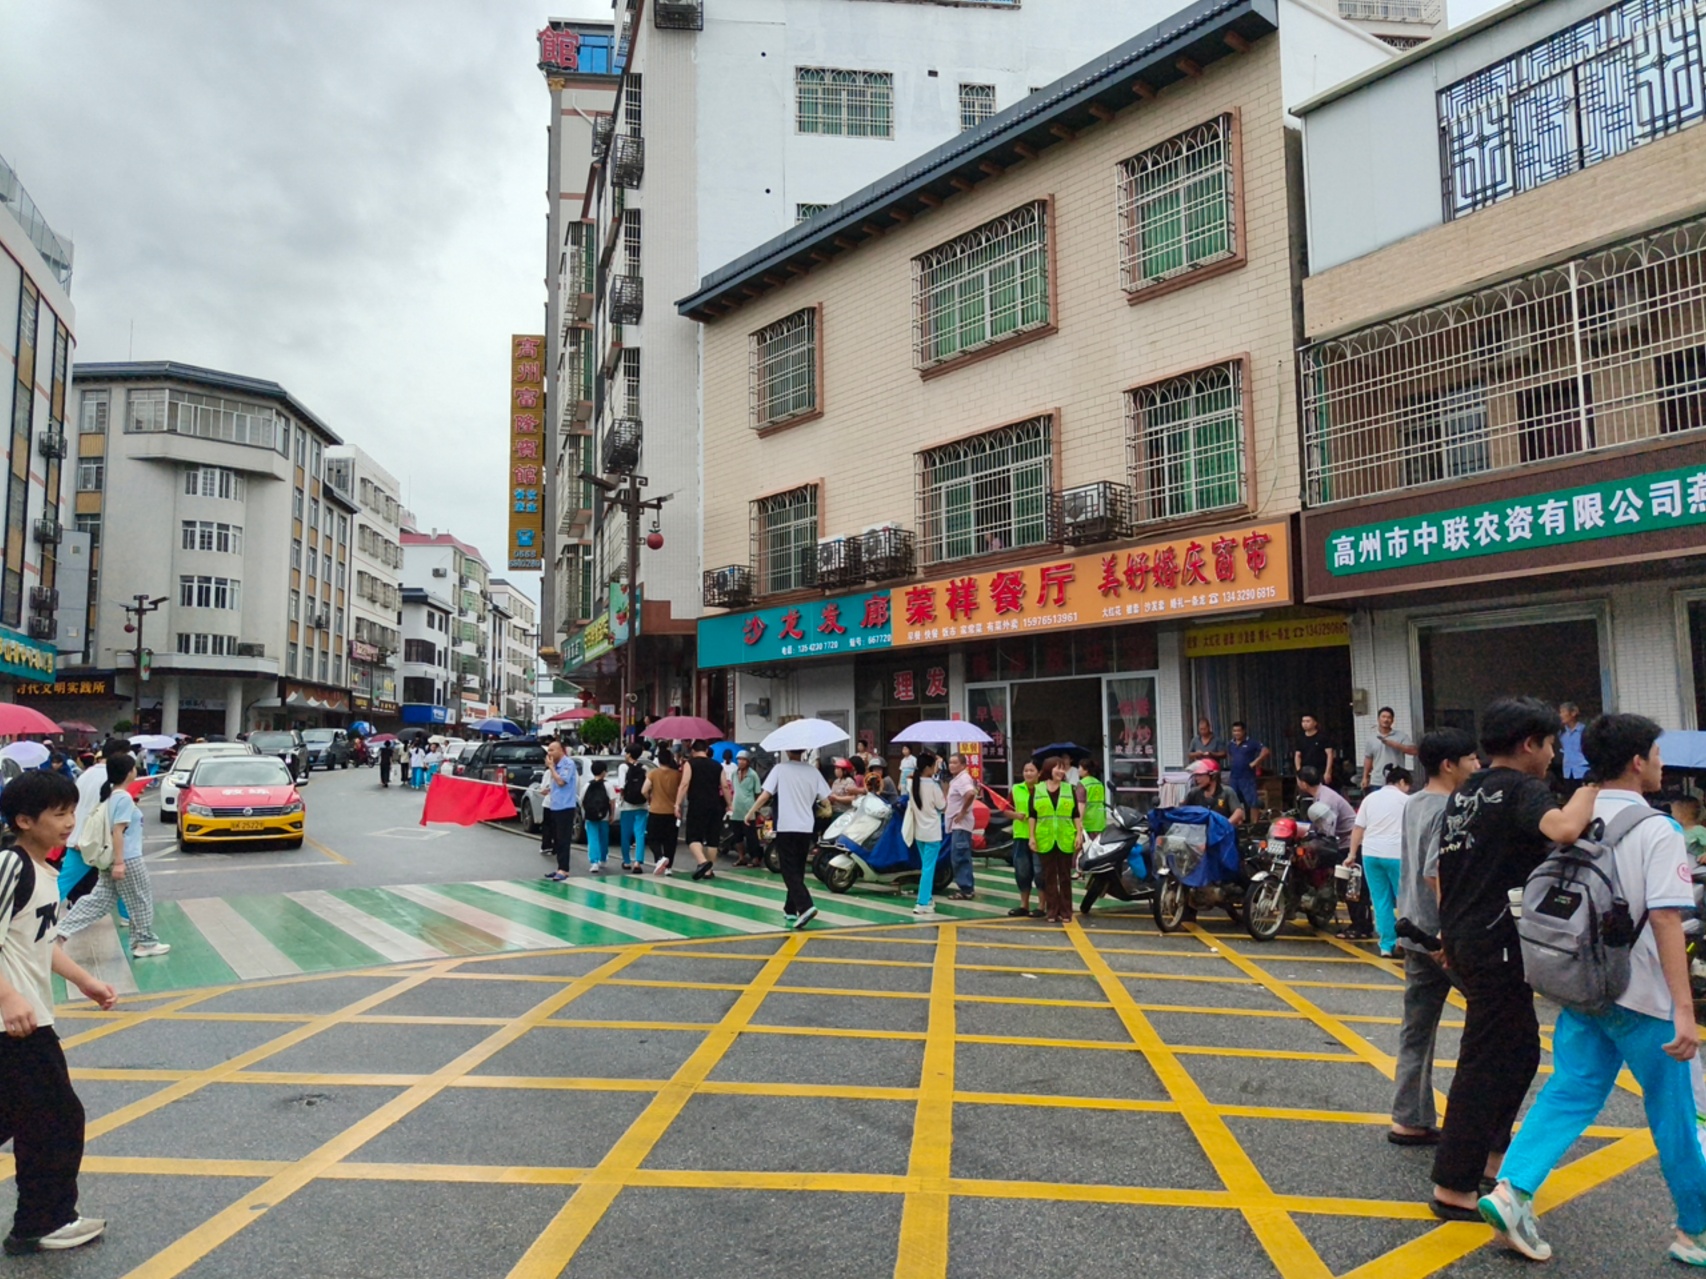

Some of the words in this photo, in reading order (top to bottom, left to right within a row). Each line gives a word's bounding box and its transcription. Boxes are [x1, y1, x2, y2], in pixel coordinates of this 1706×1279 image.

[537, 26, 580, 69] 館
[904, 562, 1077, 626] 荣祥餐厅
[893, 667, 947, 701] 理发
